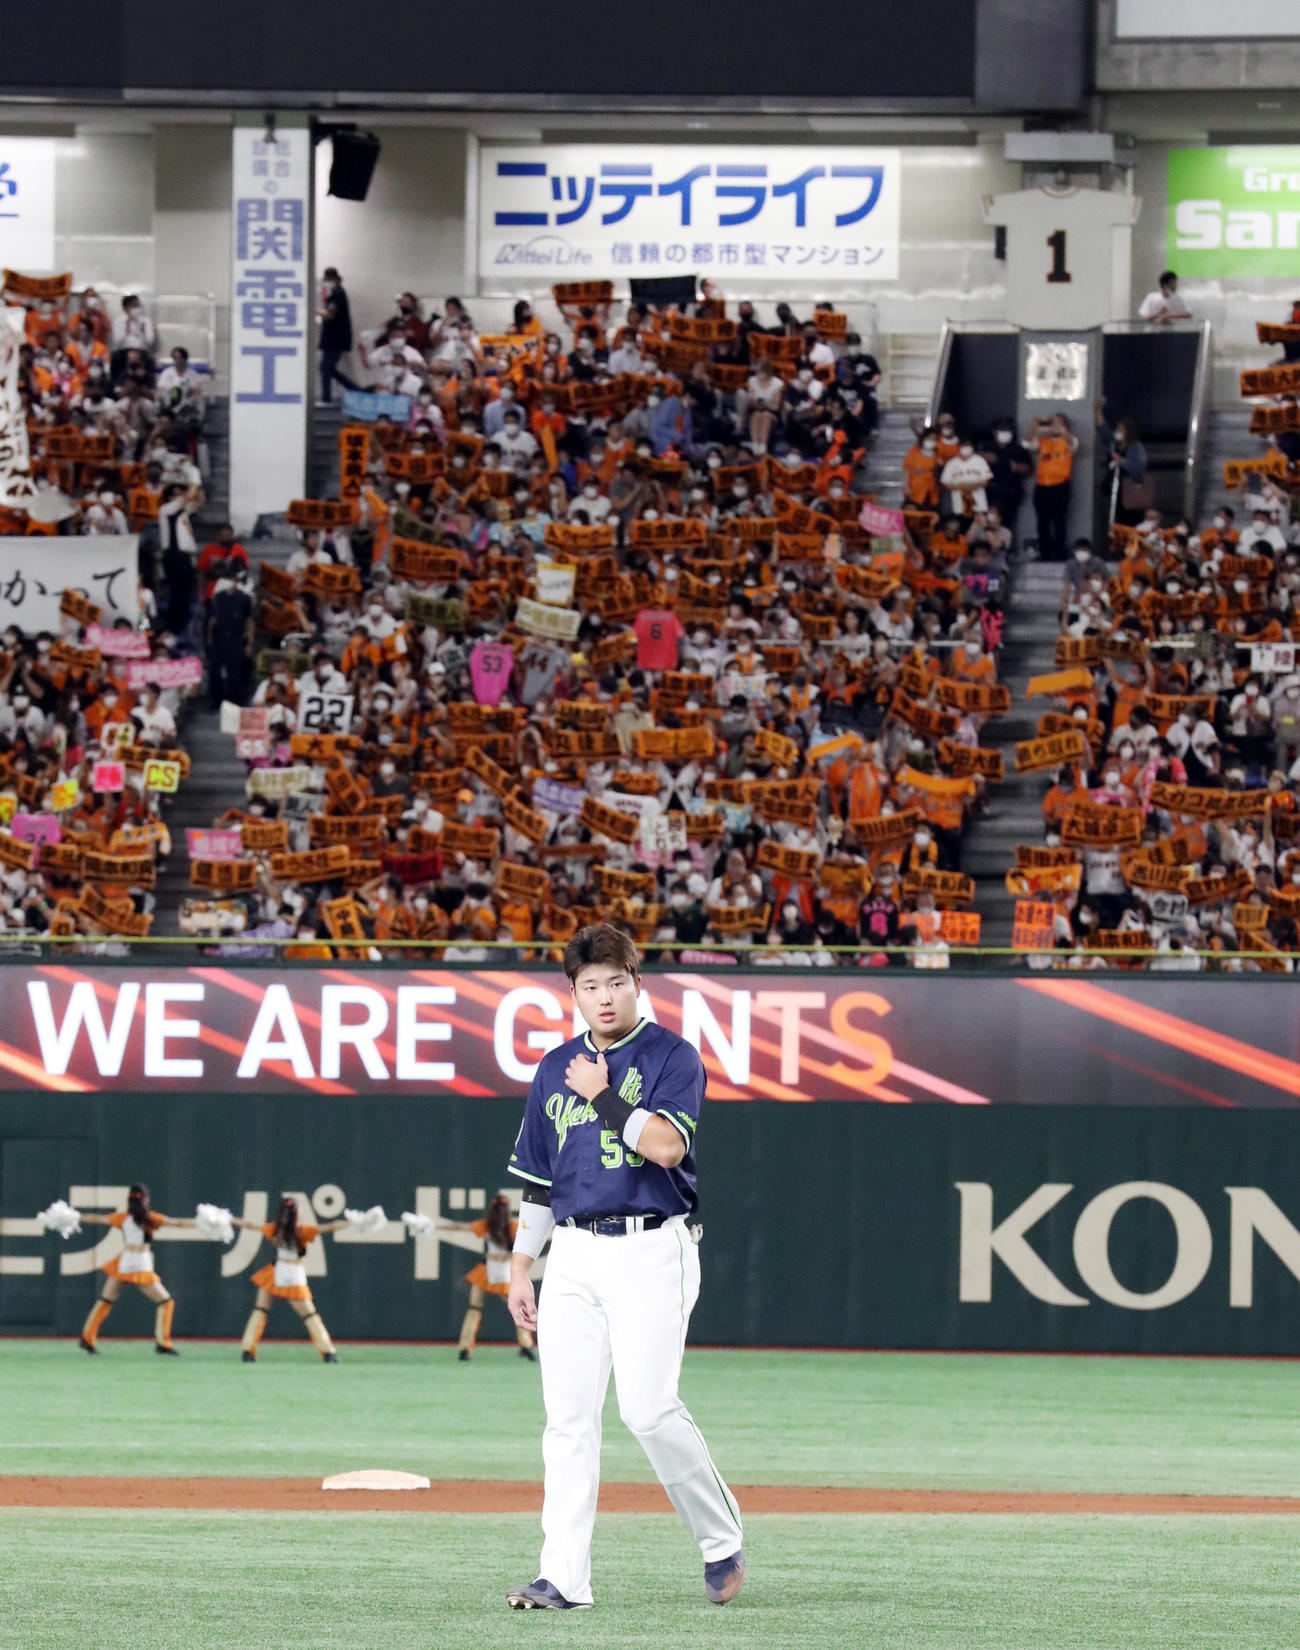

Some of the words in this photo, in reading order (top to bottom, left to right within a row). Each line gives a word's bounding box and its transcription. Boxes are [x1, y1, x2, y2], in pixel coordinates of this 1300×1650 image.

[495, 162, 885, 227] ニッテイライフ
[1046, 229, 1072, 283] 1
[237, 199, 303, 403] 関電工
[0, 567, 126, 610] かって
[304, 696, 346, 731] 22
[146, 764, 176, 788] CS
[27, 981, 205, 1077] WE
[236, 984, 457, 1080] ARE
[494, 986, 892, 1087] GNTS
[545, 1066, 643, 1154] Yaklt
